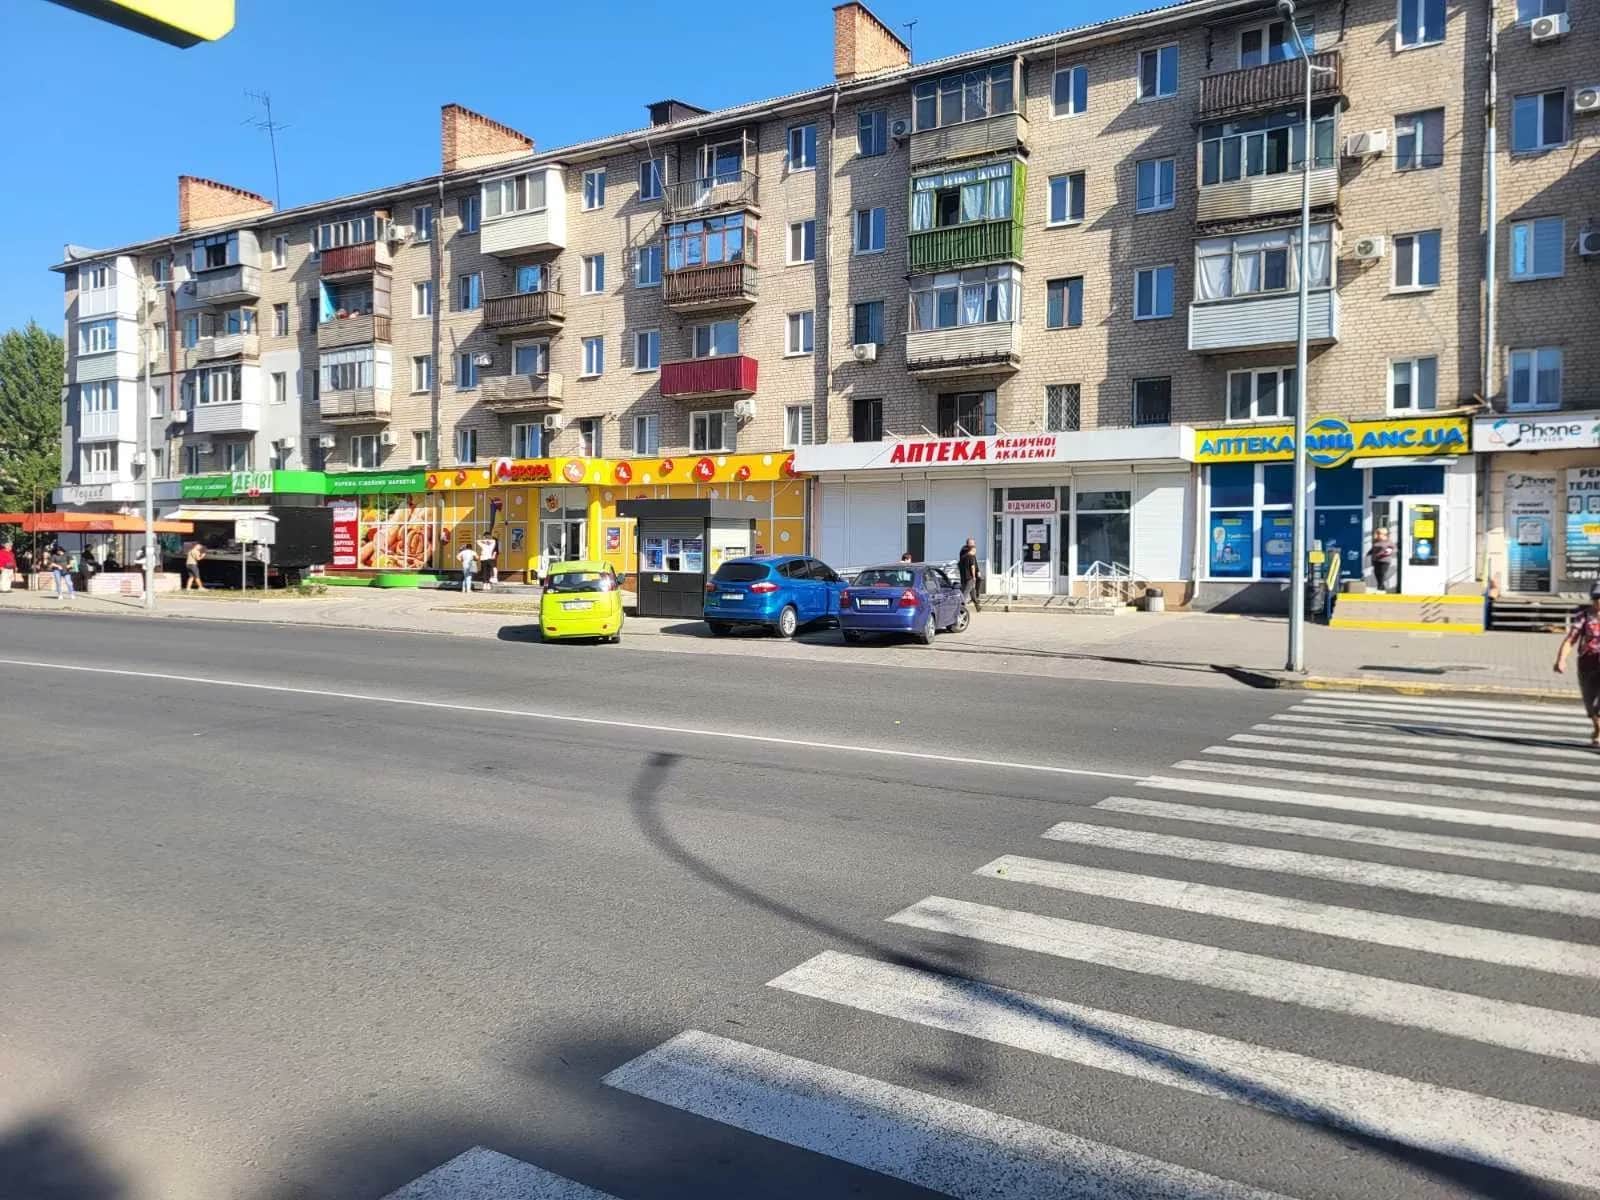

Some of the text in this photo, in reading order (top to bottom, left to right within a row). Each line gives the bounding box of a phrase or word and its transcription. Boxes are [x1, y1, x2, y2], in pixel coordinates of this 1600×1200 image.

[1360, 427, 1465, 449] ANC.UA
[1519, 424, 1582, 437] Phone
[890, 440, 987, 463] АПТЕКА
[1200, 436, 1296, 455] АПТЕКА
[1008, 501, 1051, 510] ВІДЧИНЕНО
